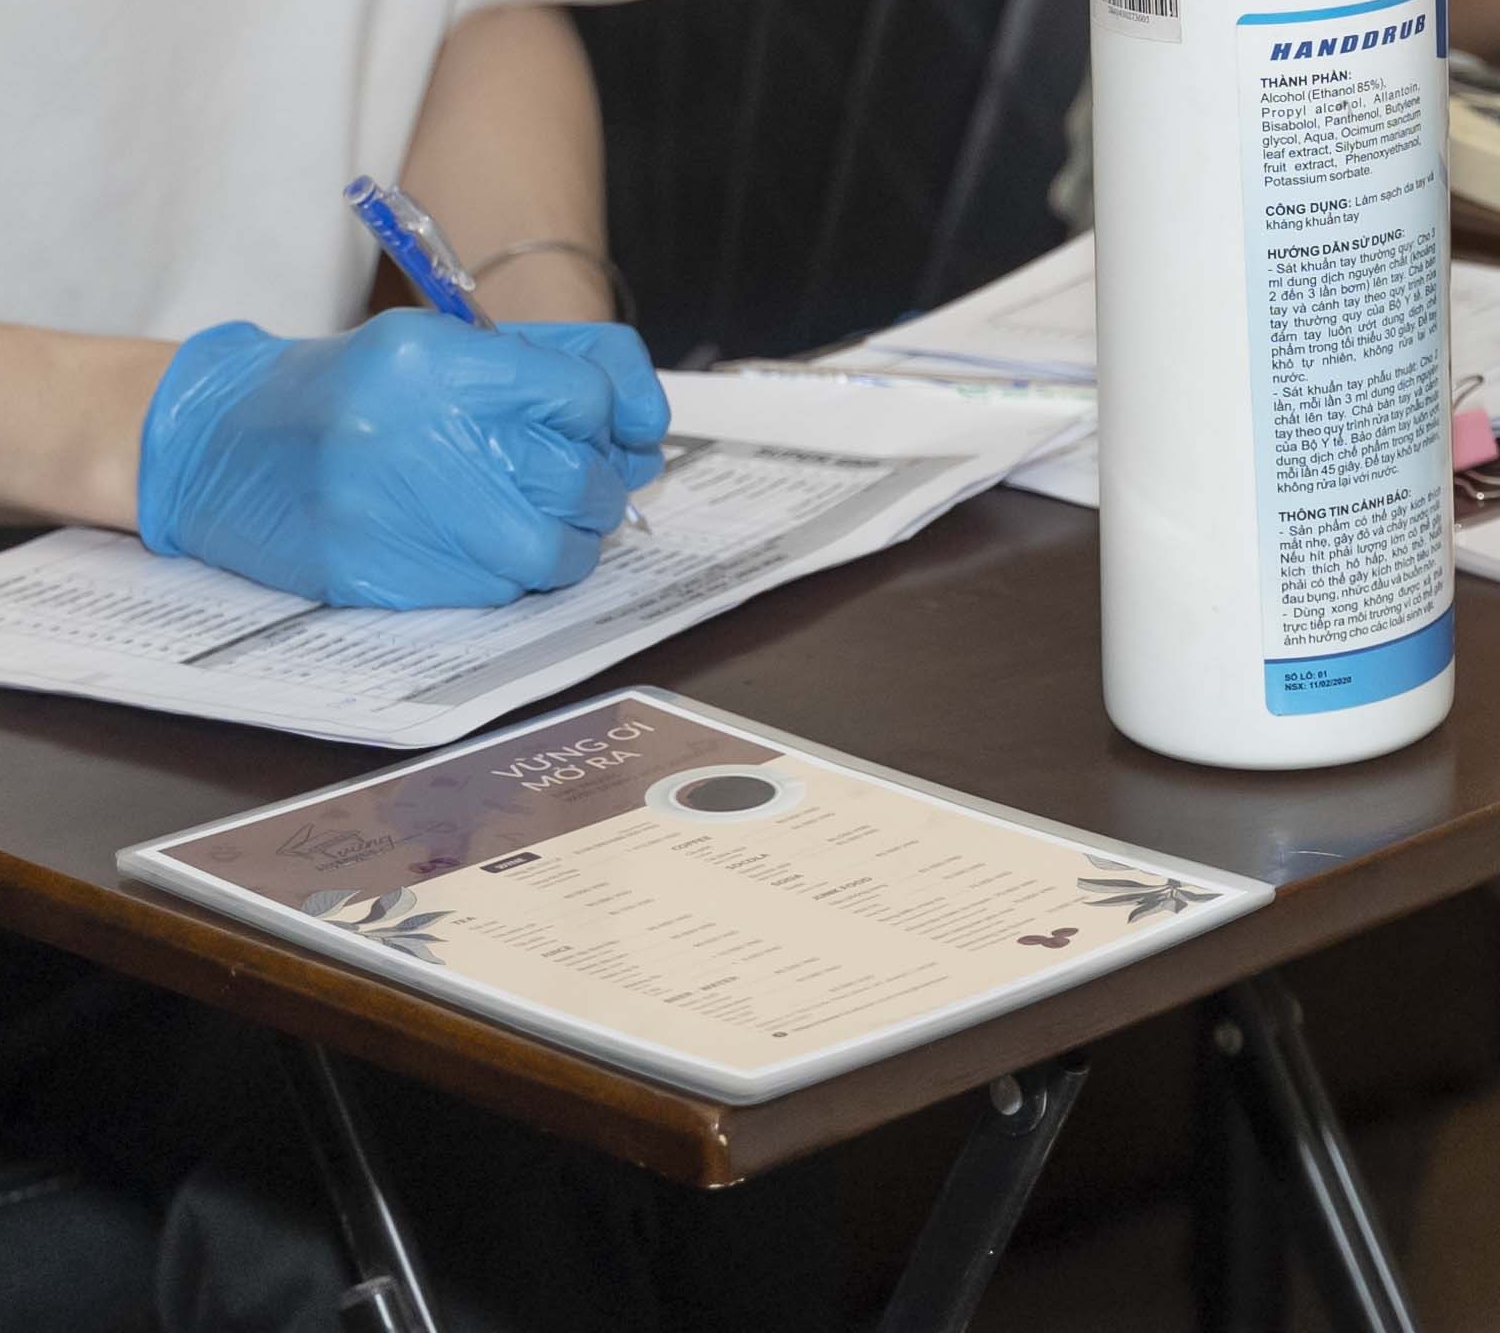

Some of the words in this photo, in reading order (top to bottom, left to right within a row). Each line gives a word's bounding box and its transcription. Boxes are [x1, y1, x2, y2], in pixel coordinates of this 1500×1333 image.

[1270, 14, 1426, 61] HANDDRUB
[1260, 75, 1307, 88] THÀNH
[1260, 92, 1305, 103] Alcohol
[1308, 87, 1355, 101] (Ethanol
[1262, 107, 1306, 121] Propyl
[1262, 119, 1320, 132] Bisabolol,
[1325, 109, 1382, 127] Panthenol,
[1385, 97, 1420, 115] Butylene
[1262, 134, 1300, 148] glycol,
[1303, 131, 1338, 145] Aqua,
[1341, 123, 1384, 138] Ocimum
[1387, 109, 1421, 128] sanctum
[1263, 149, 1284, 159] leaf
[1336, 135, 1378, 153] Silybum
[1264, 163, 1286, 173] fruit
[1265, 171, 1327, 187] Potassium
[1266, 203, 1306, 216] CÔNG
[1343, 212, 1359, 223] tay
[1340, 257, 1356, 268] tay
[1268, 278, 1282, 288] ml
[1287, 276, 1317, 287] dung
[1321, 270, 1344, 286] dịch
[1269, 291, 1276, 301] 2
[1308, 289, 1315, 298] 3
[1270, 305, 1288, 317] tay
[1344, 297, 1360, 309] tay
[1364, 291, 1386, 303] theo
[1270, 319, 1288, 331] tay
[1342, 311, 1362, 323] quy
[1304, 330, 1322, 341] tay
[1382, 313, 1404, 328] dung
[1309, 342, 1338, 355] trong
[1385, 327, 1396, 338] 30
[1348, 380, 1364, 391] tay
[1345, 394, 1352, 403] 3
[1356, 392, 1368, 402] ml
[1371, 385, 1395, 399] dung
[1305, 413, 1322, 423] lên
[1275, 429, 1292, 441] tay
[1296, 427, 1321, 437] theo
[1324, 425, 1344, 437] quy
[1321, 438, 1329, 448] Y
[1276, 455, 1306, 468] dung
[1310, 453, 1334, 468] dịch
[1321, 464, 1335, 475] 45
[1381, 454, 1395, 464] tay
[1277, 482, 1314, 493] không
[1329, 505, 1349, 517] TIN
[1281, 567, 1305, 577] kích
[1312, 561, 1340, 575] thích
[1311, 579, 1324, 588] có
[1282, 593, 1305, 604] đau
[1332, 601, 1358, 613] xong
[1334, 618, 1345, 626] ra
[1350, 626, 1368, 637] cho
[586, 750, 642, 769] RA
